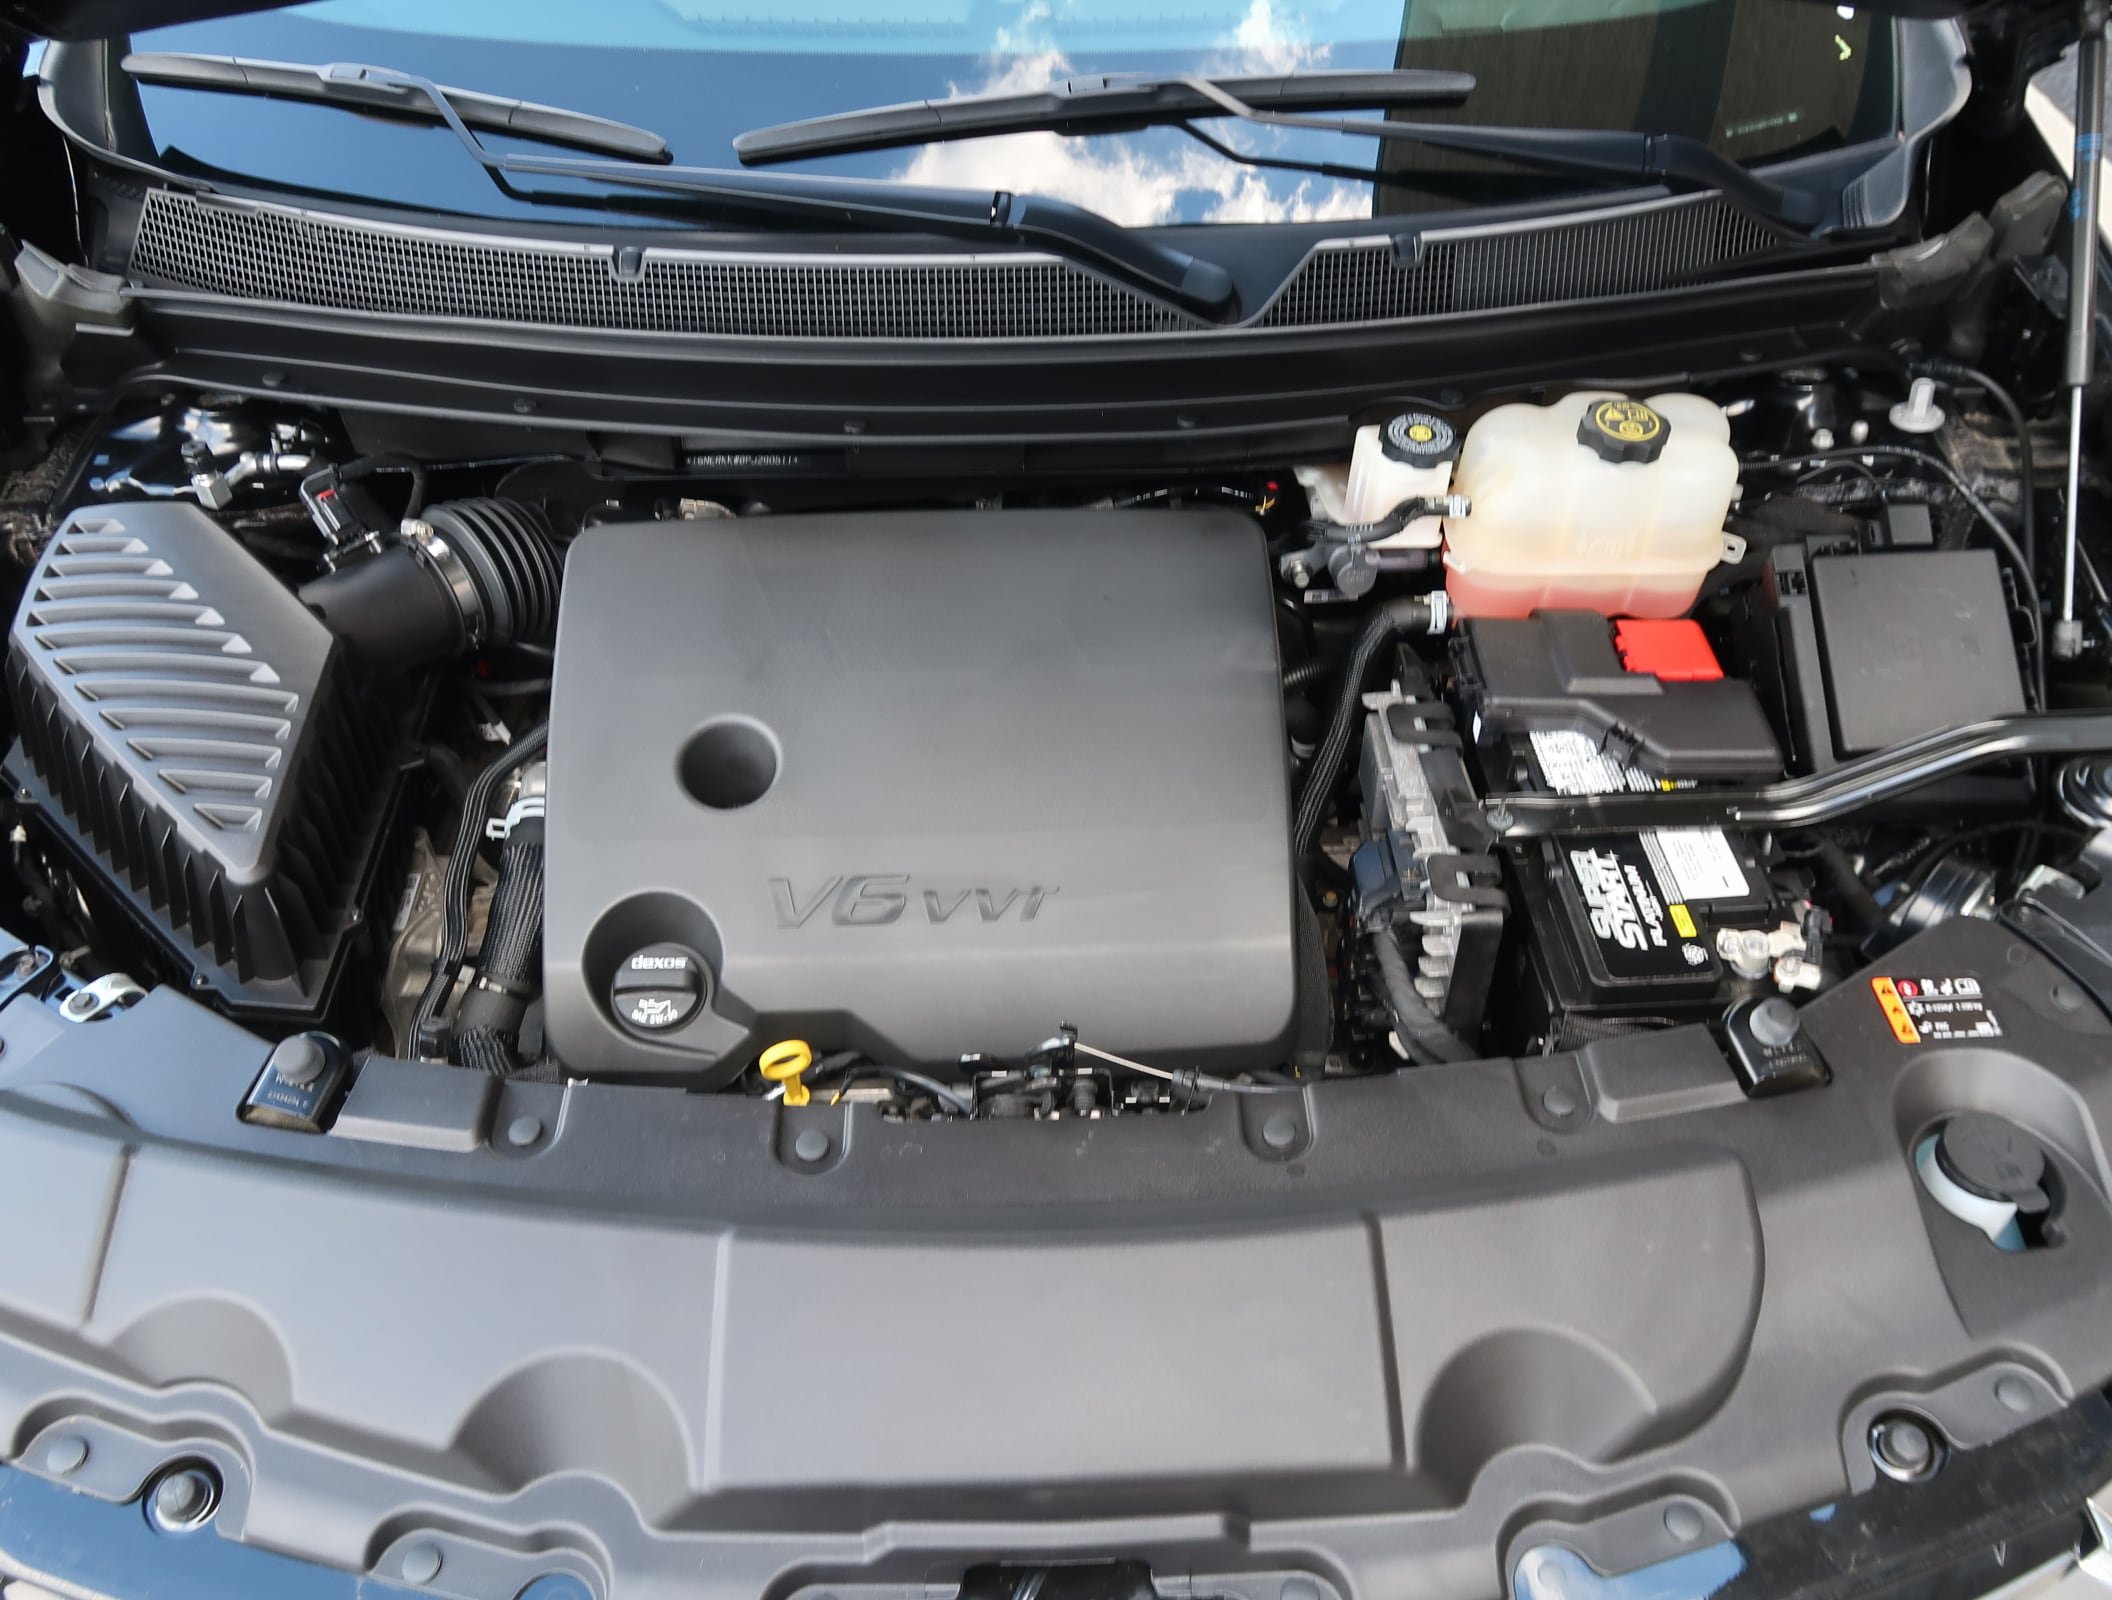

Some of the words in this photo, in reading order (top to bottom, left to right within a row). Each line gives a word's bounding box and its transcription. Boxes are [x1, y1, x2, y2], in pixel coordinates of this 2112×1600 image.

[767, 874, 910, 928] V6
[922, 885, 1060, 923] VVT
[1570, 848, 1612, 940] SUPER
[1588, 847, 1649, 951] START
[1623, 864, 1668, 947] PLATINUM
[631, 954, 689, 969] dexos
